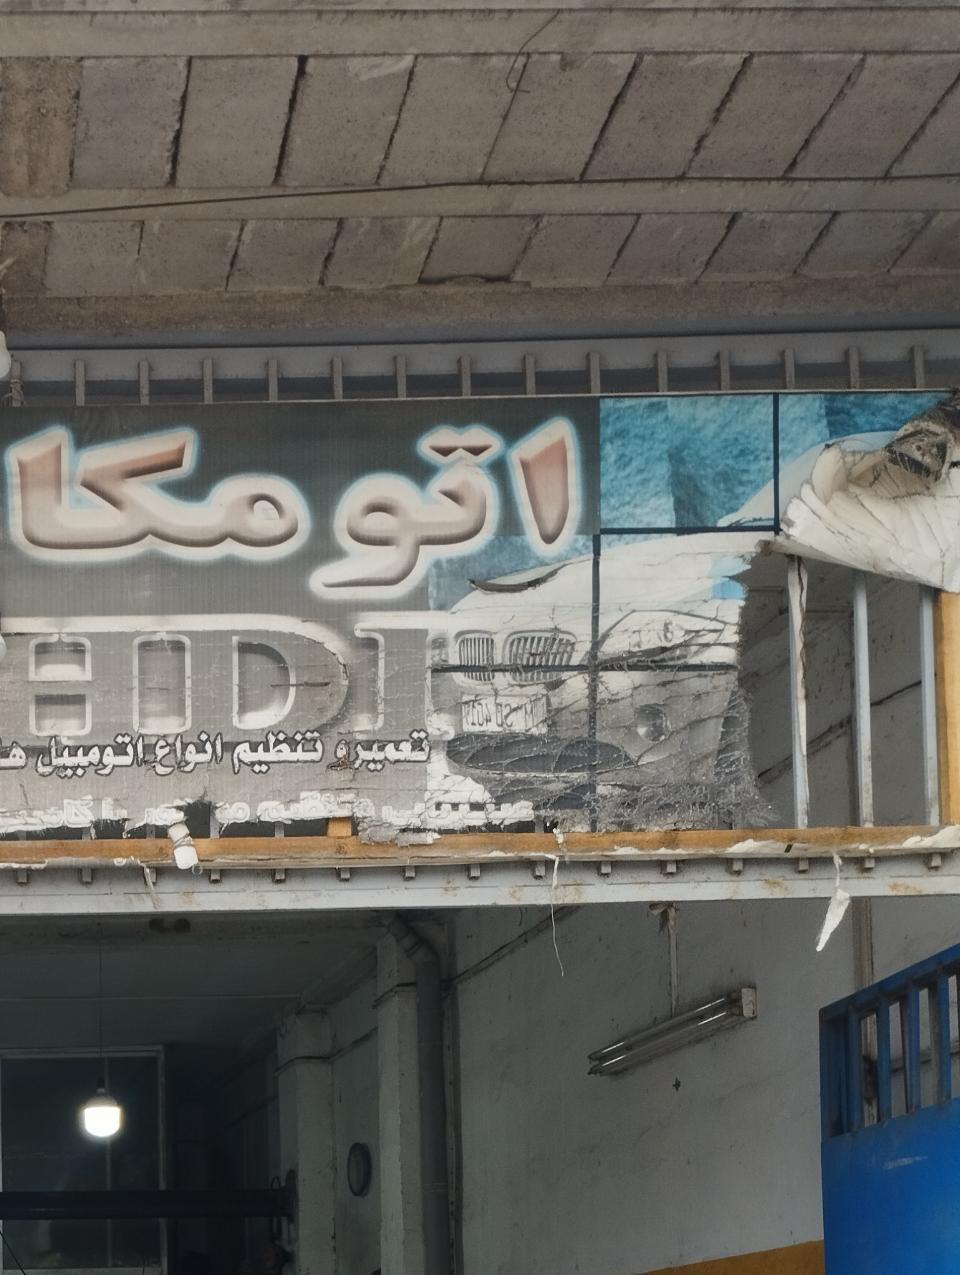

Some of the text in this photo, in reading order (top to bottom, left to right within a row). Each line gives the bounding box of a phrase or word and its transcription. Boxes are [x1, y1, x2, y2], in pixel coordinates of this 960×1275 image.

[35, 733, 144, 779] اتومبیل
[154, 730, 223, 777] انواع
[232, 730, 324, 774] تنظیم
